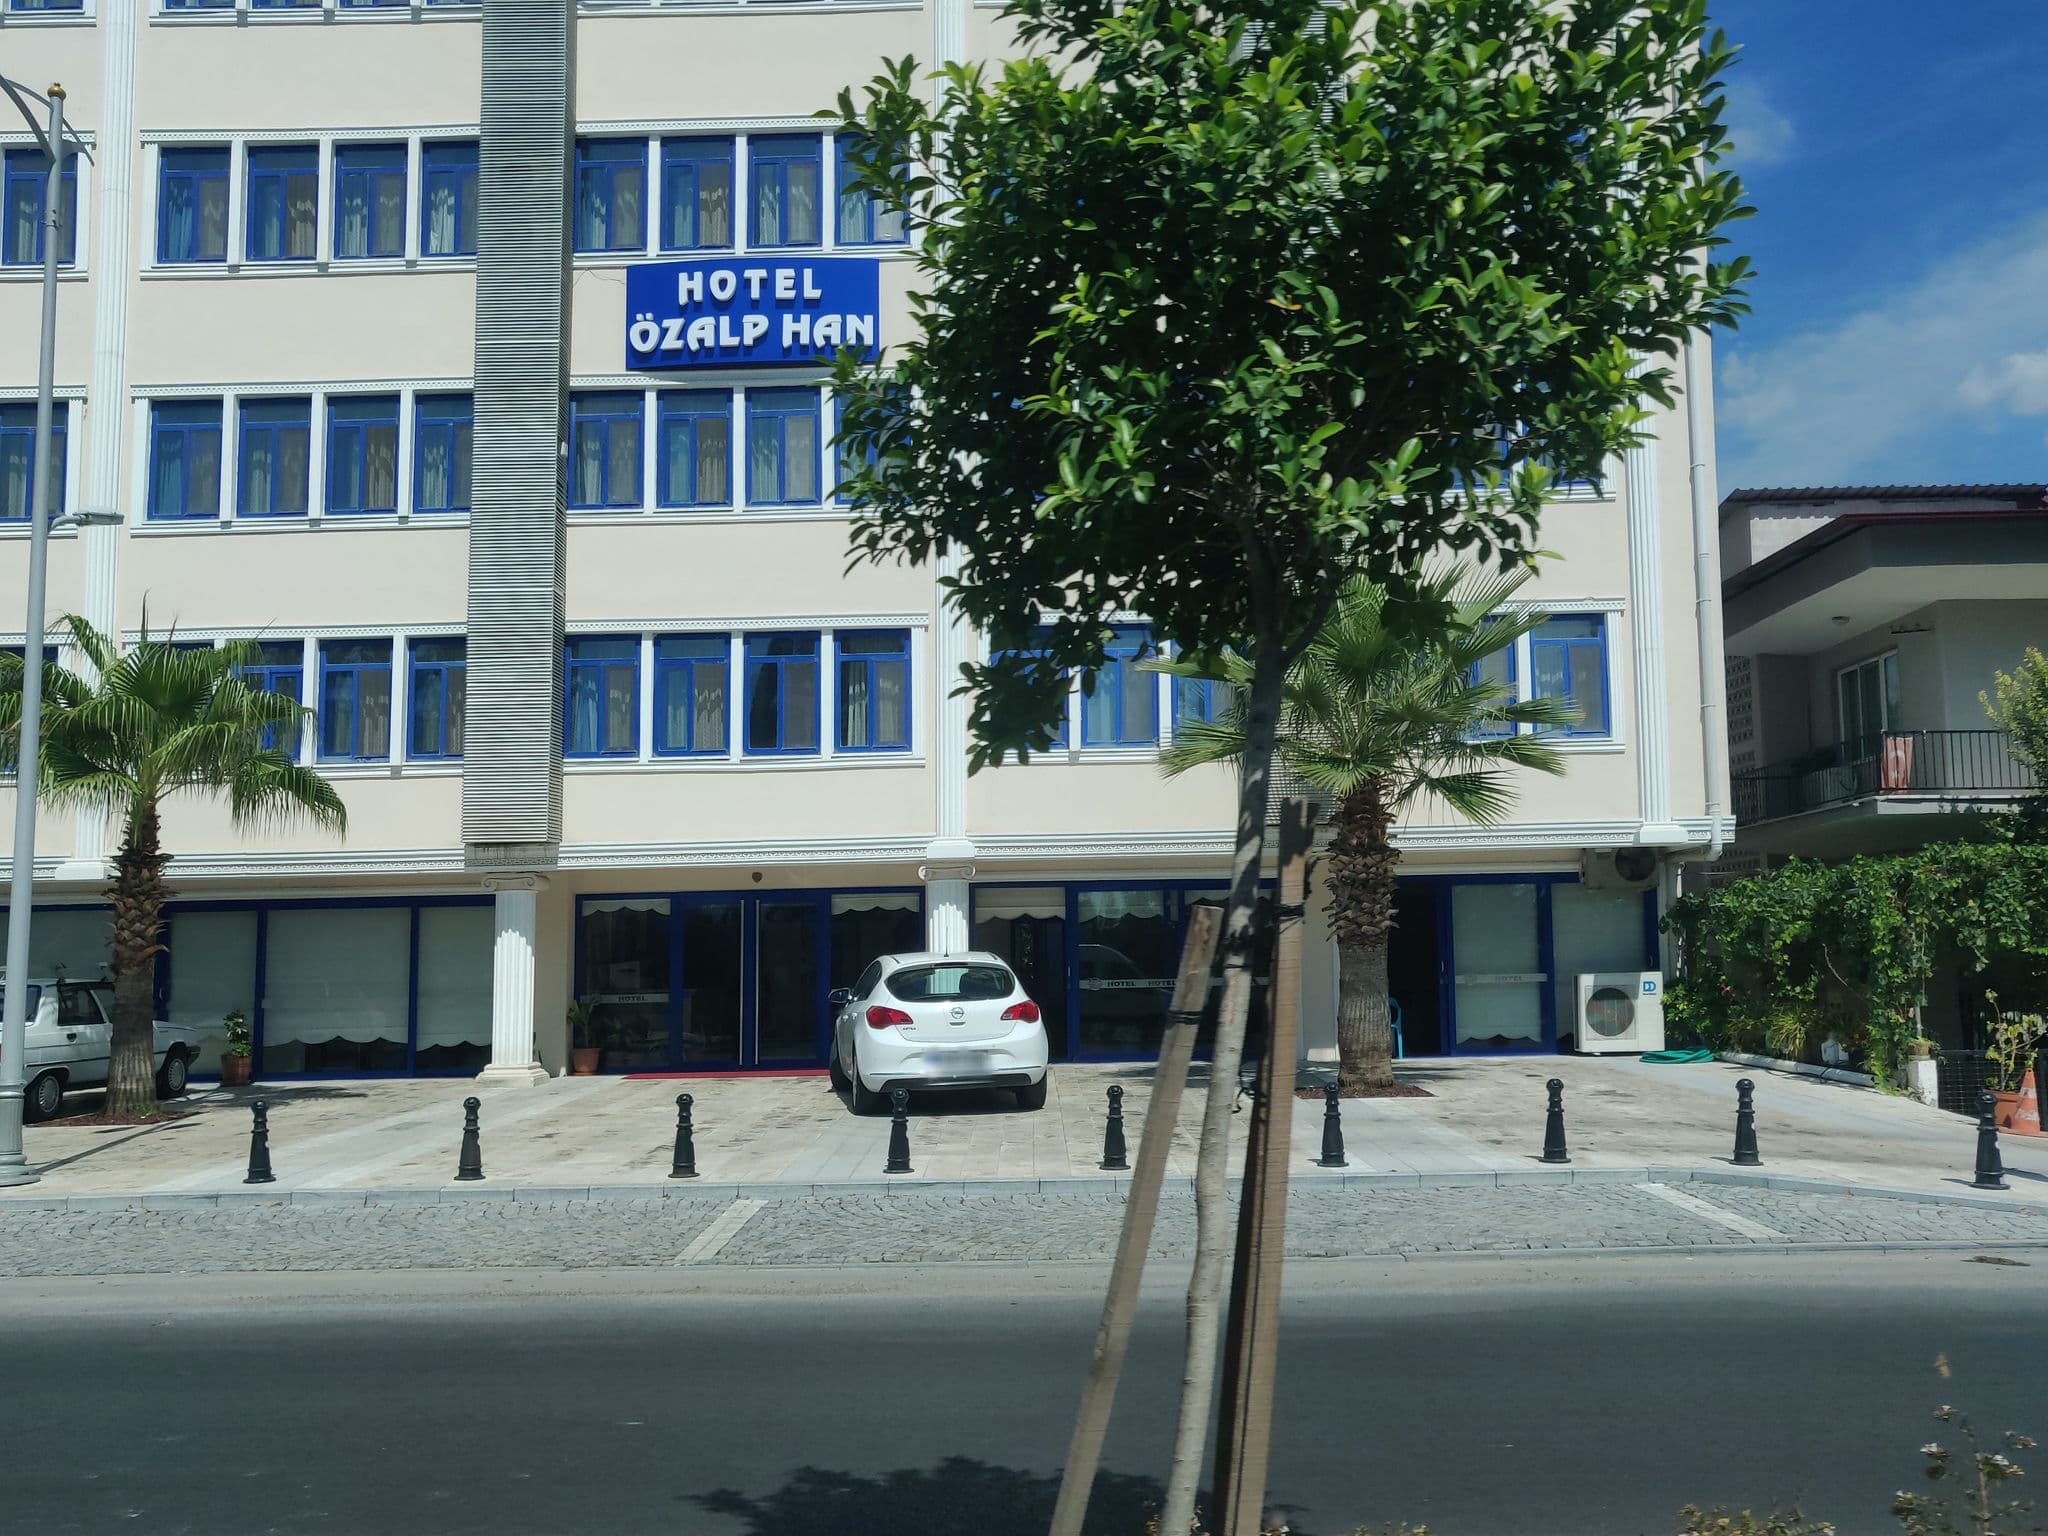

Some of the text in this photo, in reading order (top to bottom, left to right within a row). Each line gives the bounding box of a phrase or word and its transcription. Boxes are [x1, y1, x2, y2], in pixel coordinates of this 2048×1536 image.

[678, 267, 822, 306] HOTEL
[629, 312, 874, 353] ÖZALP HAN
